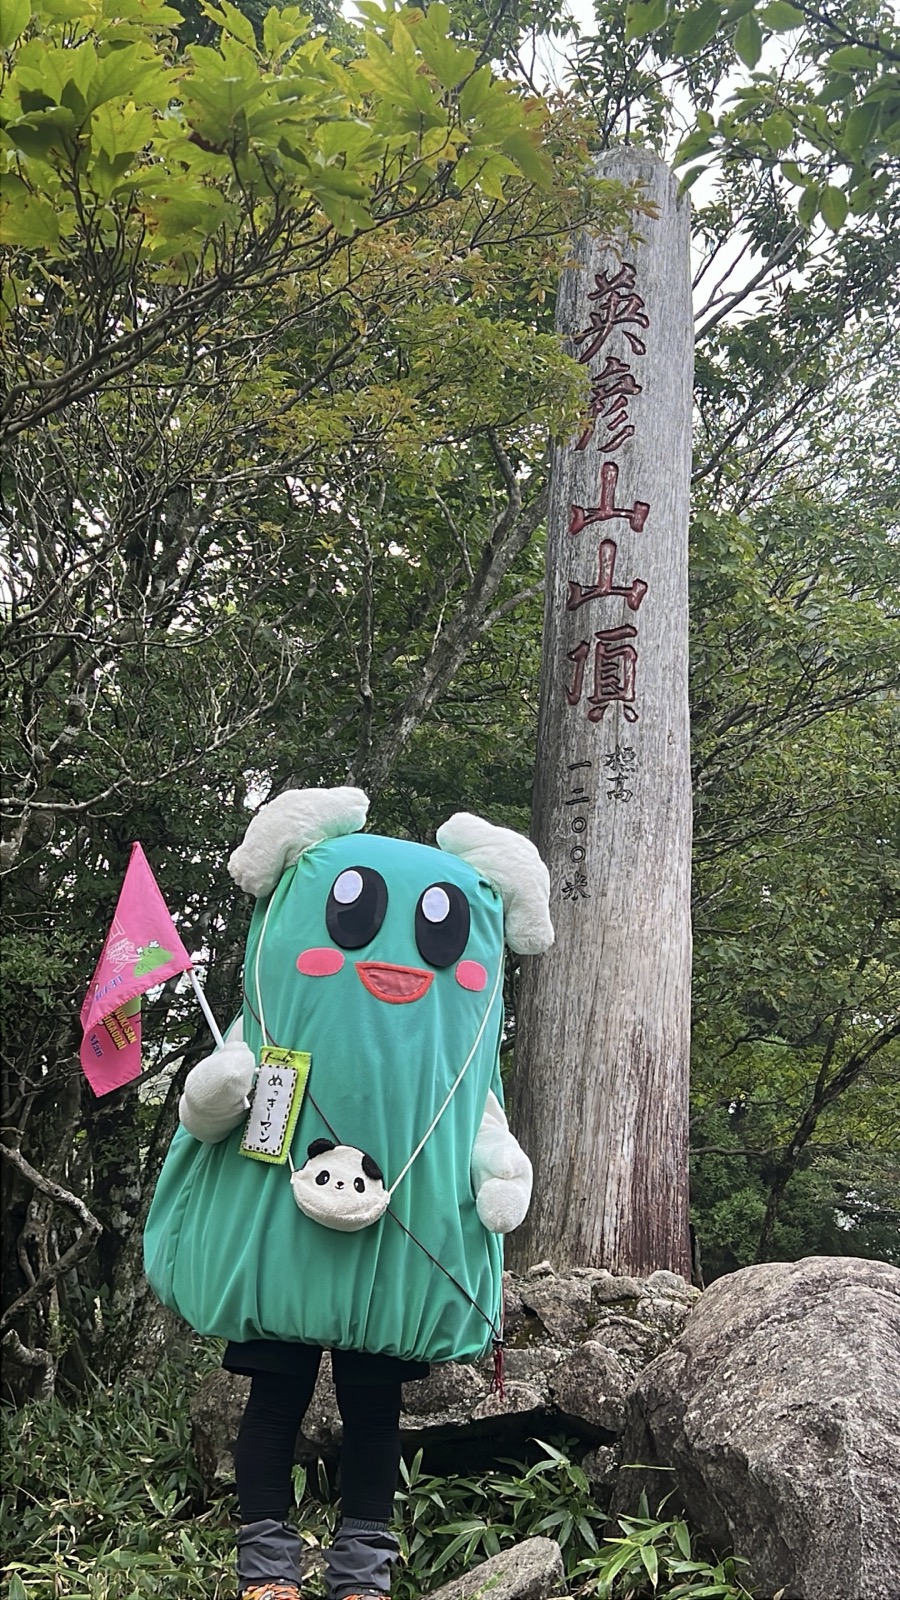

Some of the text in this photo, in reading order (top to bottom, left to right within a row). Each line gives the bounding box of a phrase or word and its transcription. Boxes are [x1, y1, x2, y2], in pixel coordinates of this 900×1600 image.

[563, 262, 650, 723] 英彦山山頂
[603, 744, 637, 803] 標高
[123, 1026, 138, 1044] SAN
